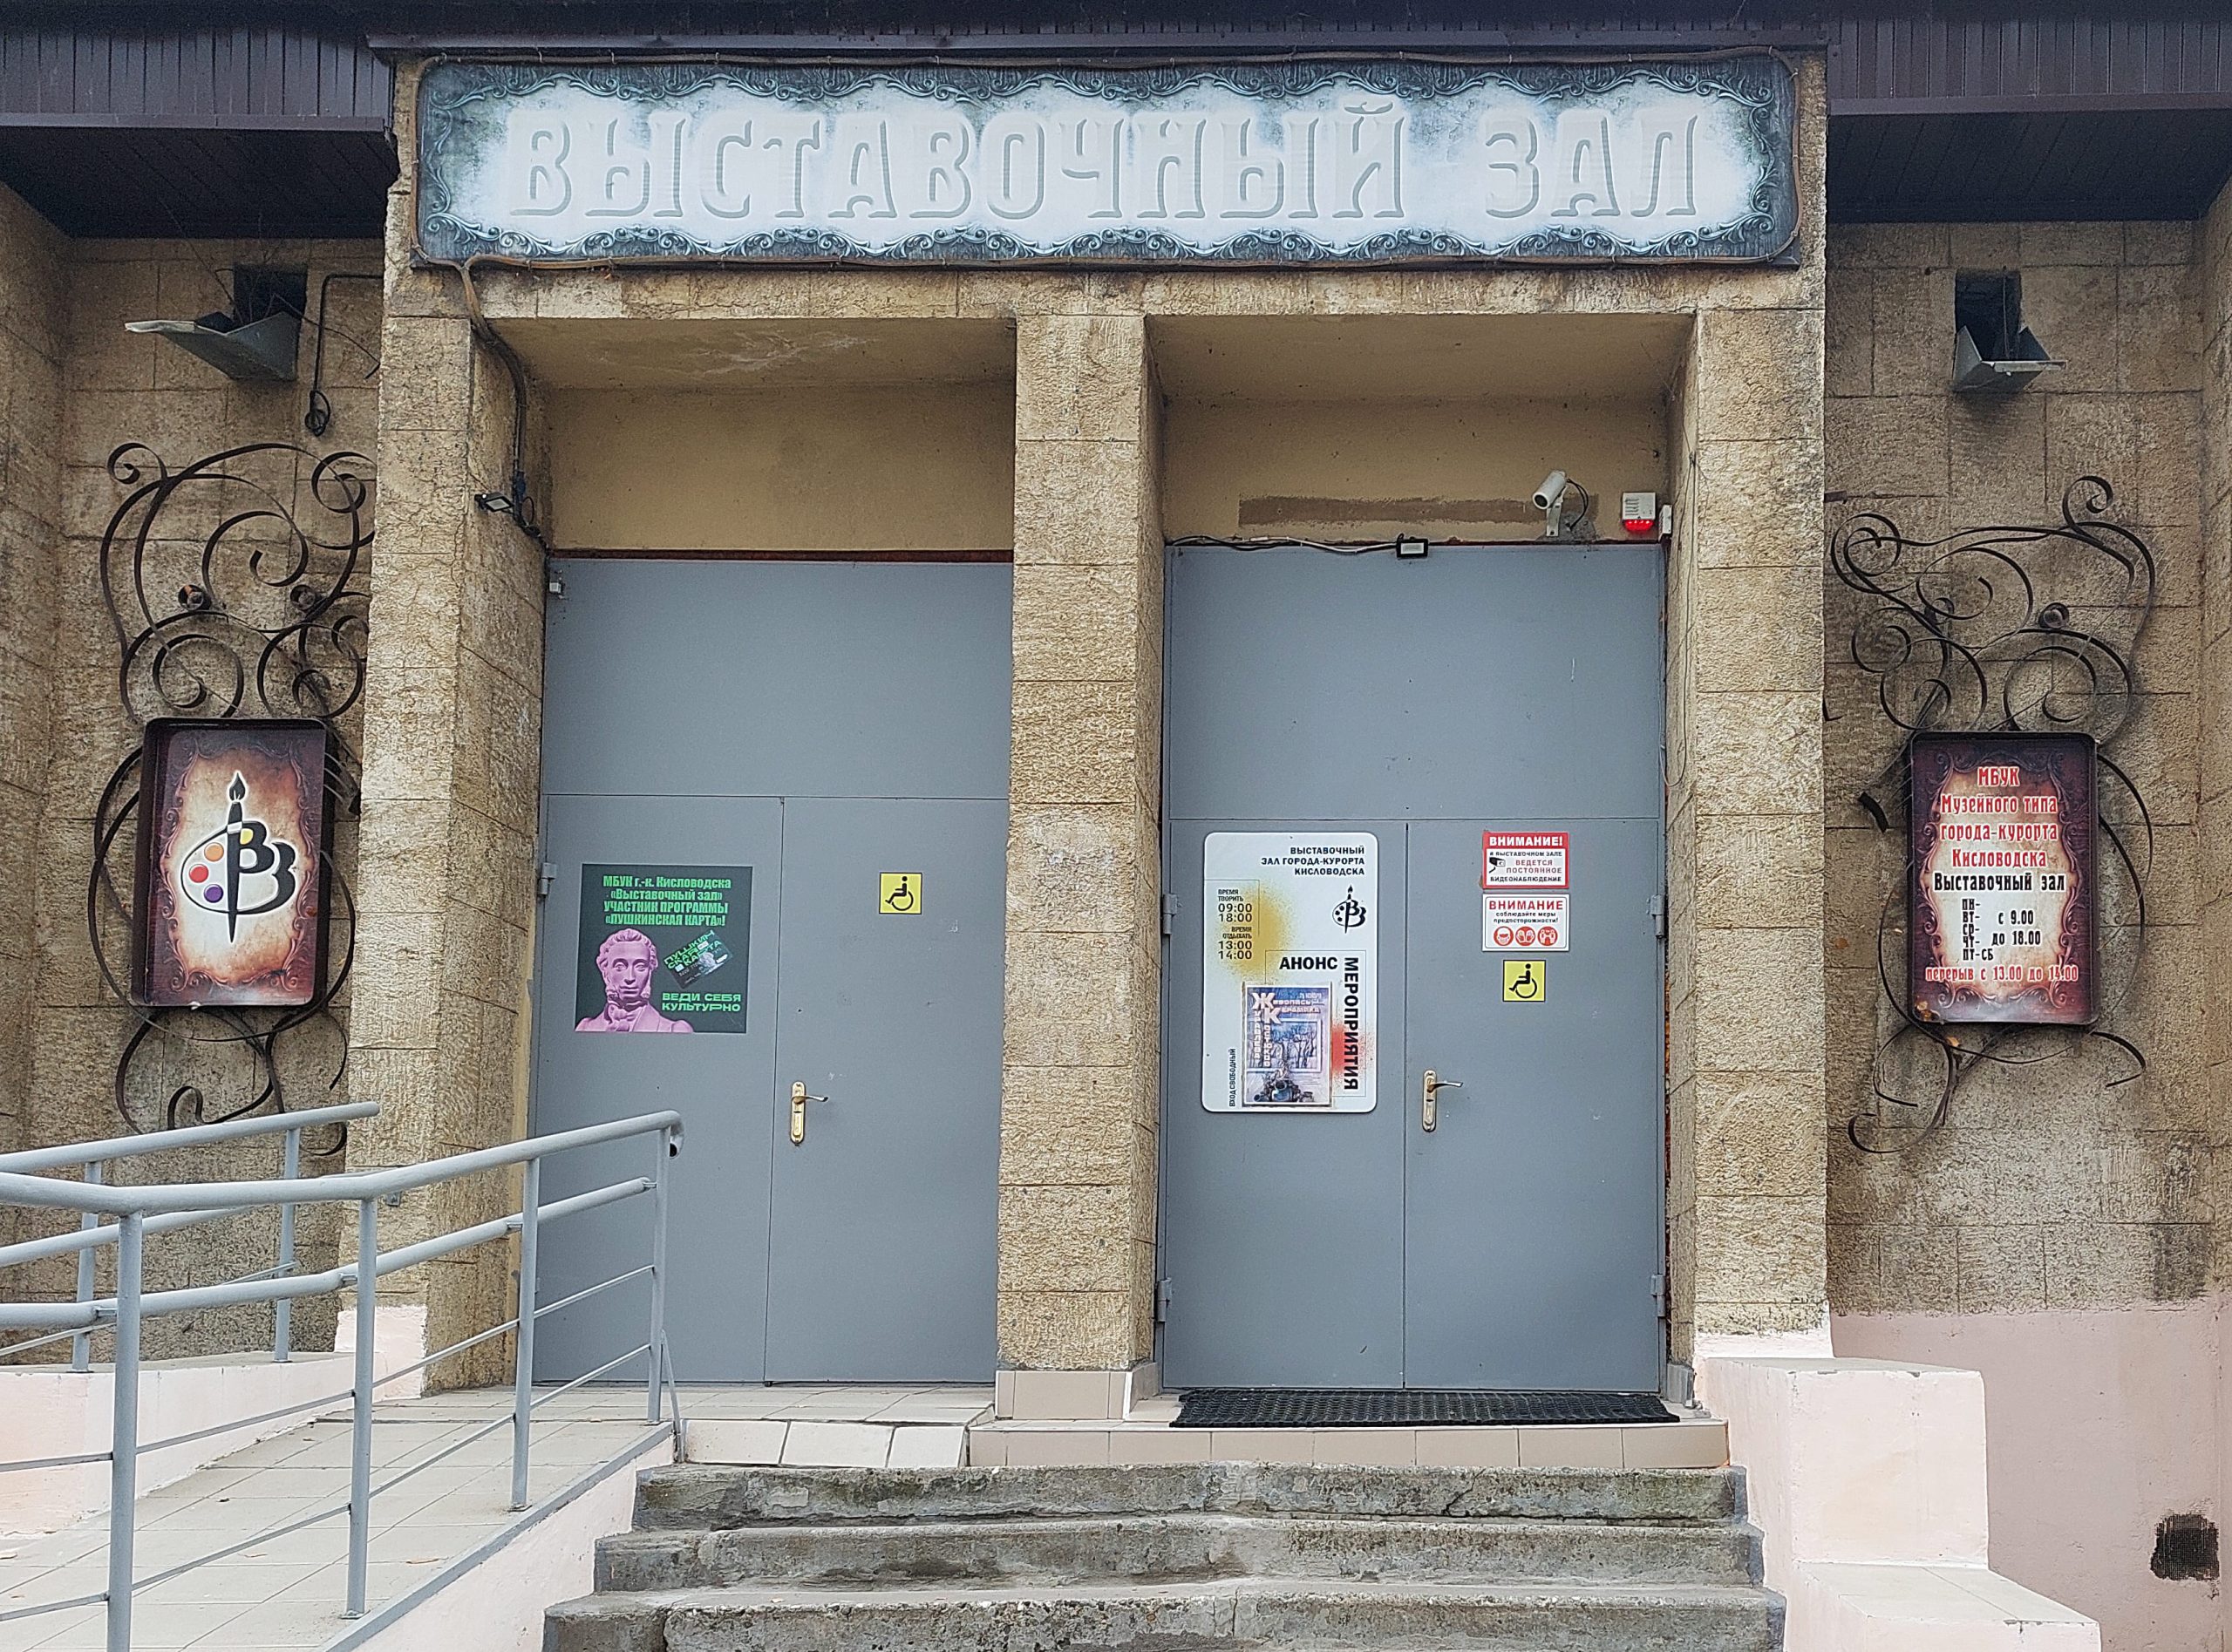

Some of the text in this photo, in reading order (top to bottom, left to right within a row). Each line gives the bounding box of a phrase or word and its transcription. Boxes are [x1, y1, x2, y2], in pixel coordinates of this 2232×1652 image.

[509, 102, 1701, 220] ВЫСТАВОЧНЫЙ ЗАЛ
[1977, 766, 2019, 786] МБУК
[1941, 794, 2058, 814] Музейного типа
[1940, 824, 2058, 841] города-курорта
[1489, 836, 1563, 846] ВНИМАНИЕ!
[1290, 845, 1364, 855] ВЫСТАВОЧНЫЙ
[1262, 857, 1365, 867] ЗАЛ ГОРОДА-КУРОРТА
[1952, 849, 2047, 868] Кисловодска
[1295, 867, 1365, 876] КИСЛОВОДСКА
[602, 875, 633, 887] МБУК
[656, 877, 732, 889] Кисловодска
[1934, 873, 2065, 891] Выставочный зал
[611, 889, 695, 901] «Выставочный
[603, 901, 729, 914] УЧАСТНИК ПРОГРАММЫ
[1218, 903, 1252, 913] 09:00
[1489, 901, 1563, 910] ВНИМАНИЕ
[605, 914, 683, 925] «ПУШКИНСКАЯ
[1218, 913, 1252, 922] 18:00
[2011, 910, 2033, 925] 9.00
[1991, 930, 2041, 946] до 18.00
[1218, 941, 1252, 949] 13:00
[1218, 950, 1252, 960] 14:00
[1279, 956, 1337, 970] АНОНС
[1926, 968, 1974, 982] перерыв
[1992, 966, 2022, 981] 13.00
[2028, 969, 2043, 982] до
[2048, 966, 2079, 981] 14.00
[662, 992, 700, 1002] ВЕДИ
[662, 1003, 741, 1011] КУЛЬТУРНО
[1344, 957, 1359, 1090] МЕРОПРИЯТИЯ
[1228, 1048, 1237, 1107] ВХОД СВОБОДНЫЙ
